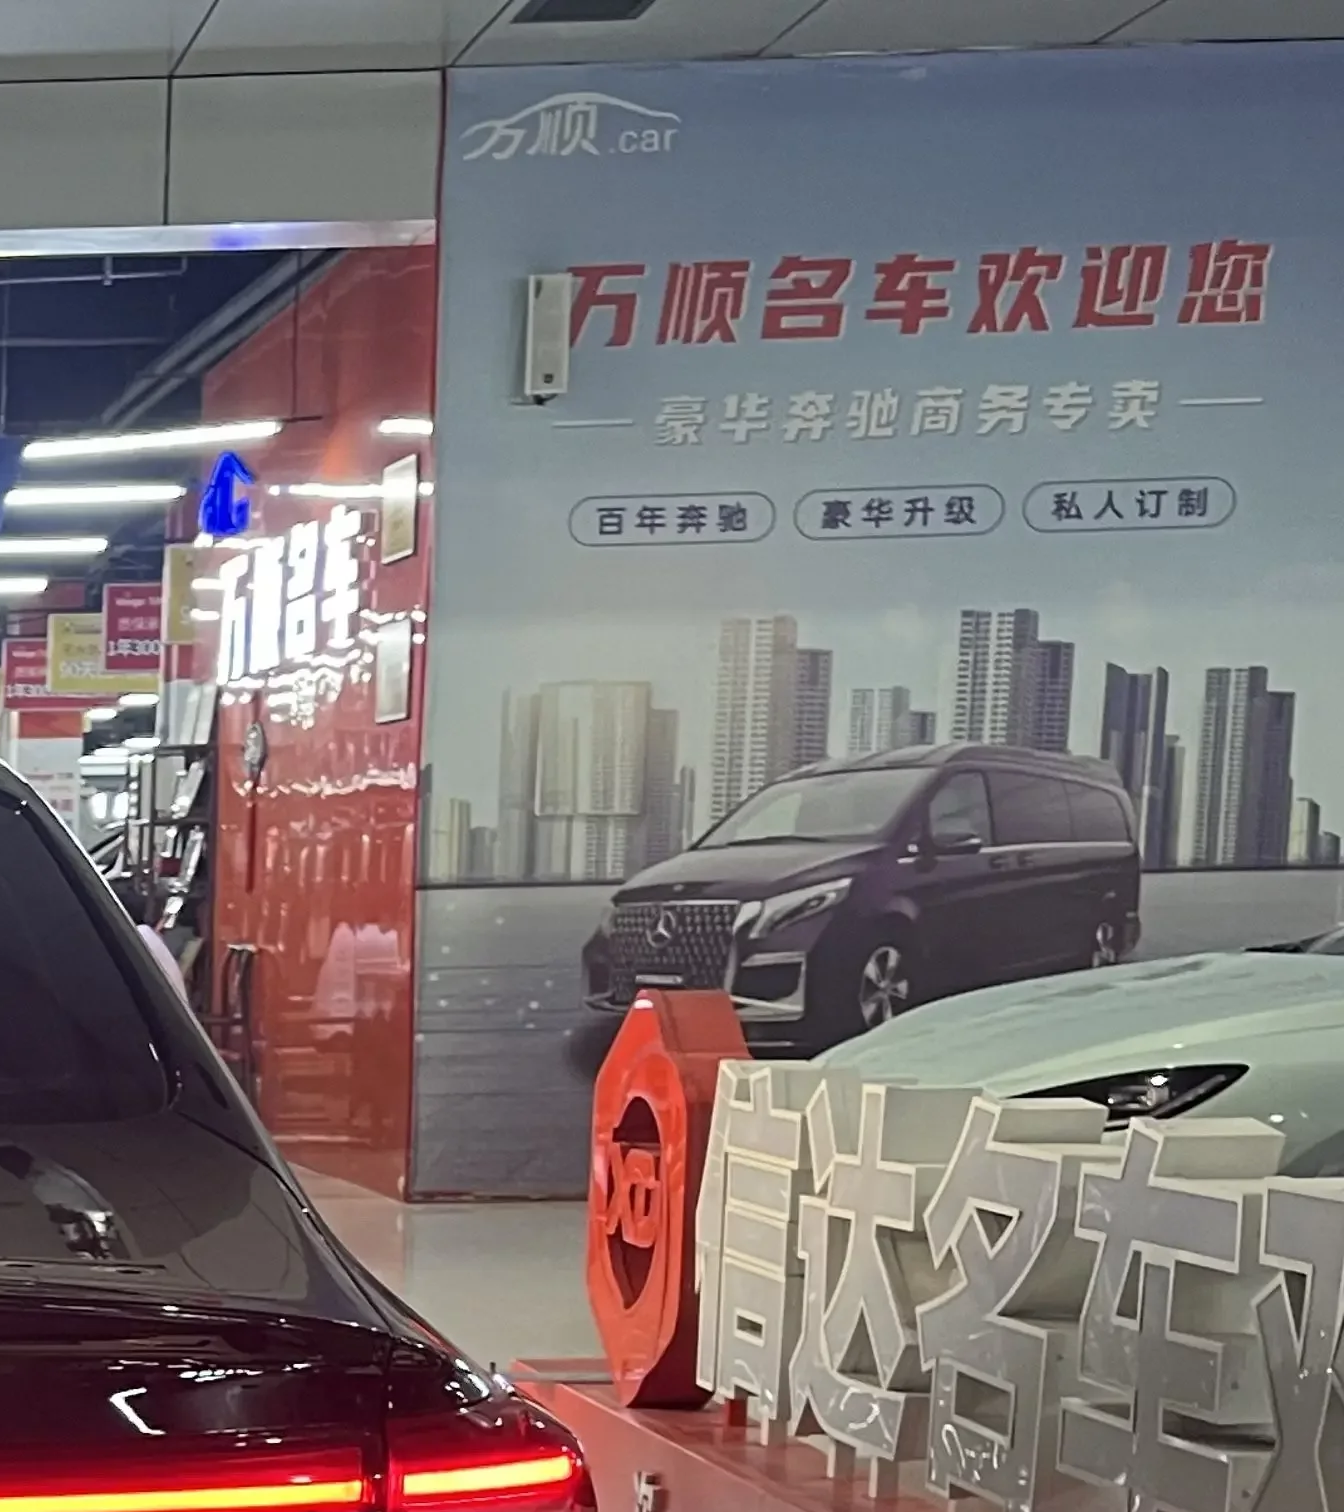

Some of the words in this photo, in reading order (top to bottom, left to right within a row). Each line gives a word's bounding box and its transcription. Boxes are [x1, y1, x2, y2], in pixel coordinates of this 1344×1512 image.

[566, 238, 1274, 349] 万顺名车欢迎您
[652, 378, 1163, 447] 豪华奔驰商务专卖
[596, 501, 749, 537] 百年奔驰
[820, 493, 978, 529] 豪华升级
[1050, 486, 1211, 522] 私人订制
